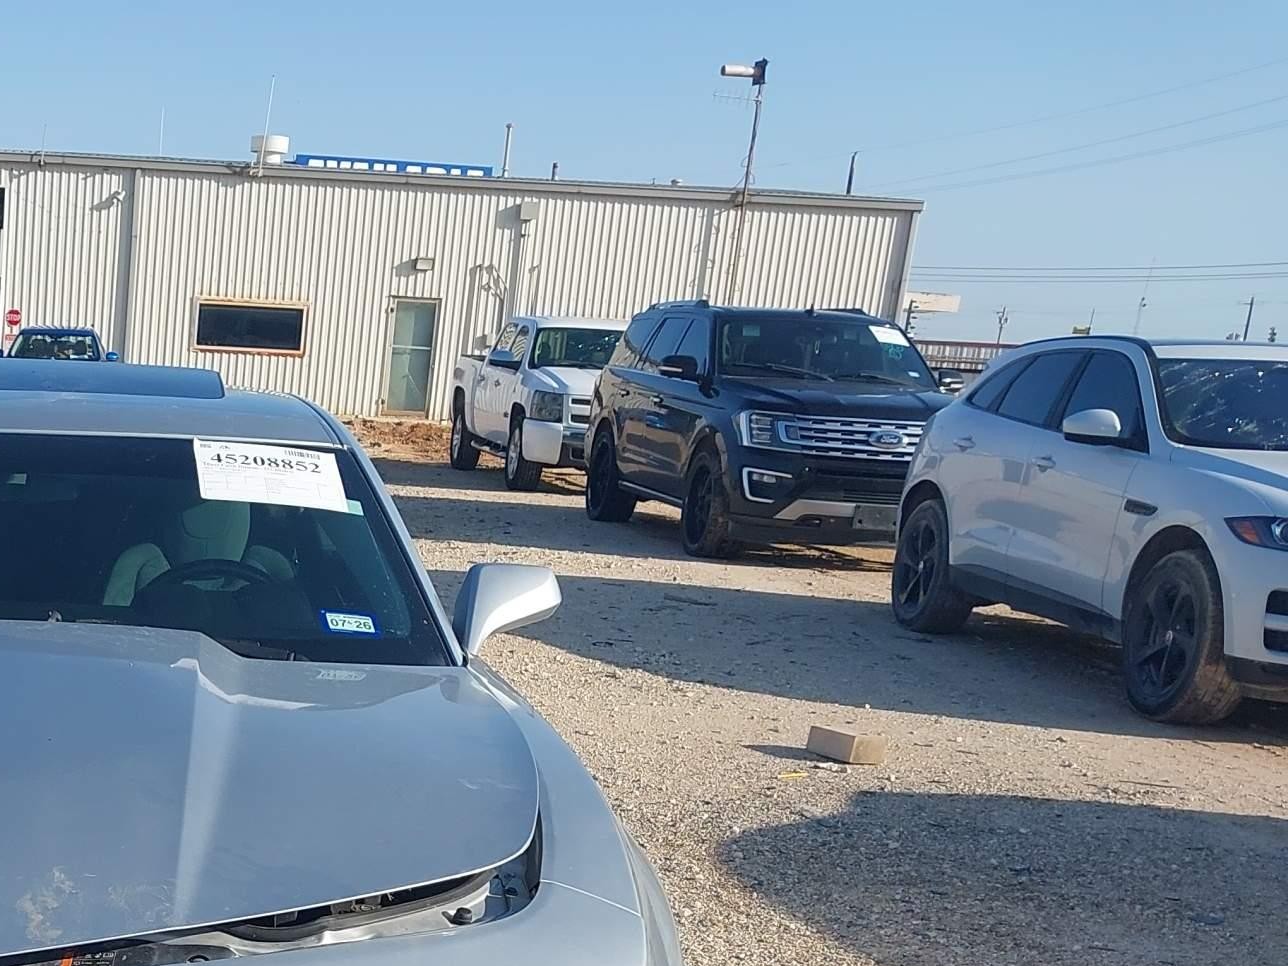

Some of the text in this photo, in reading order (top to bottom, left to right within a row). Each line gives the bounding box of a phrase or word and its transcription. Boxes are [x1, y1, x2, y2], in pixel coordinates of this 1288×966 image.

[6, 313, 21, 321] STOP
[880, 434, 900, 444] Ford
[210, 453, 321, 474] 45208852
[330, 618, 372, 630] 07 26
